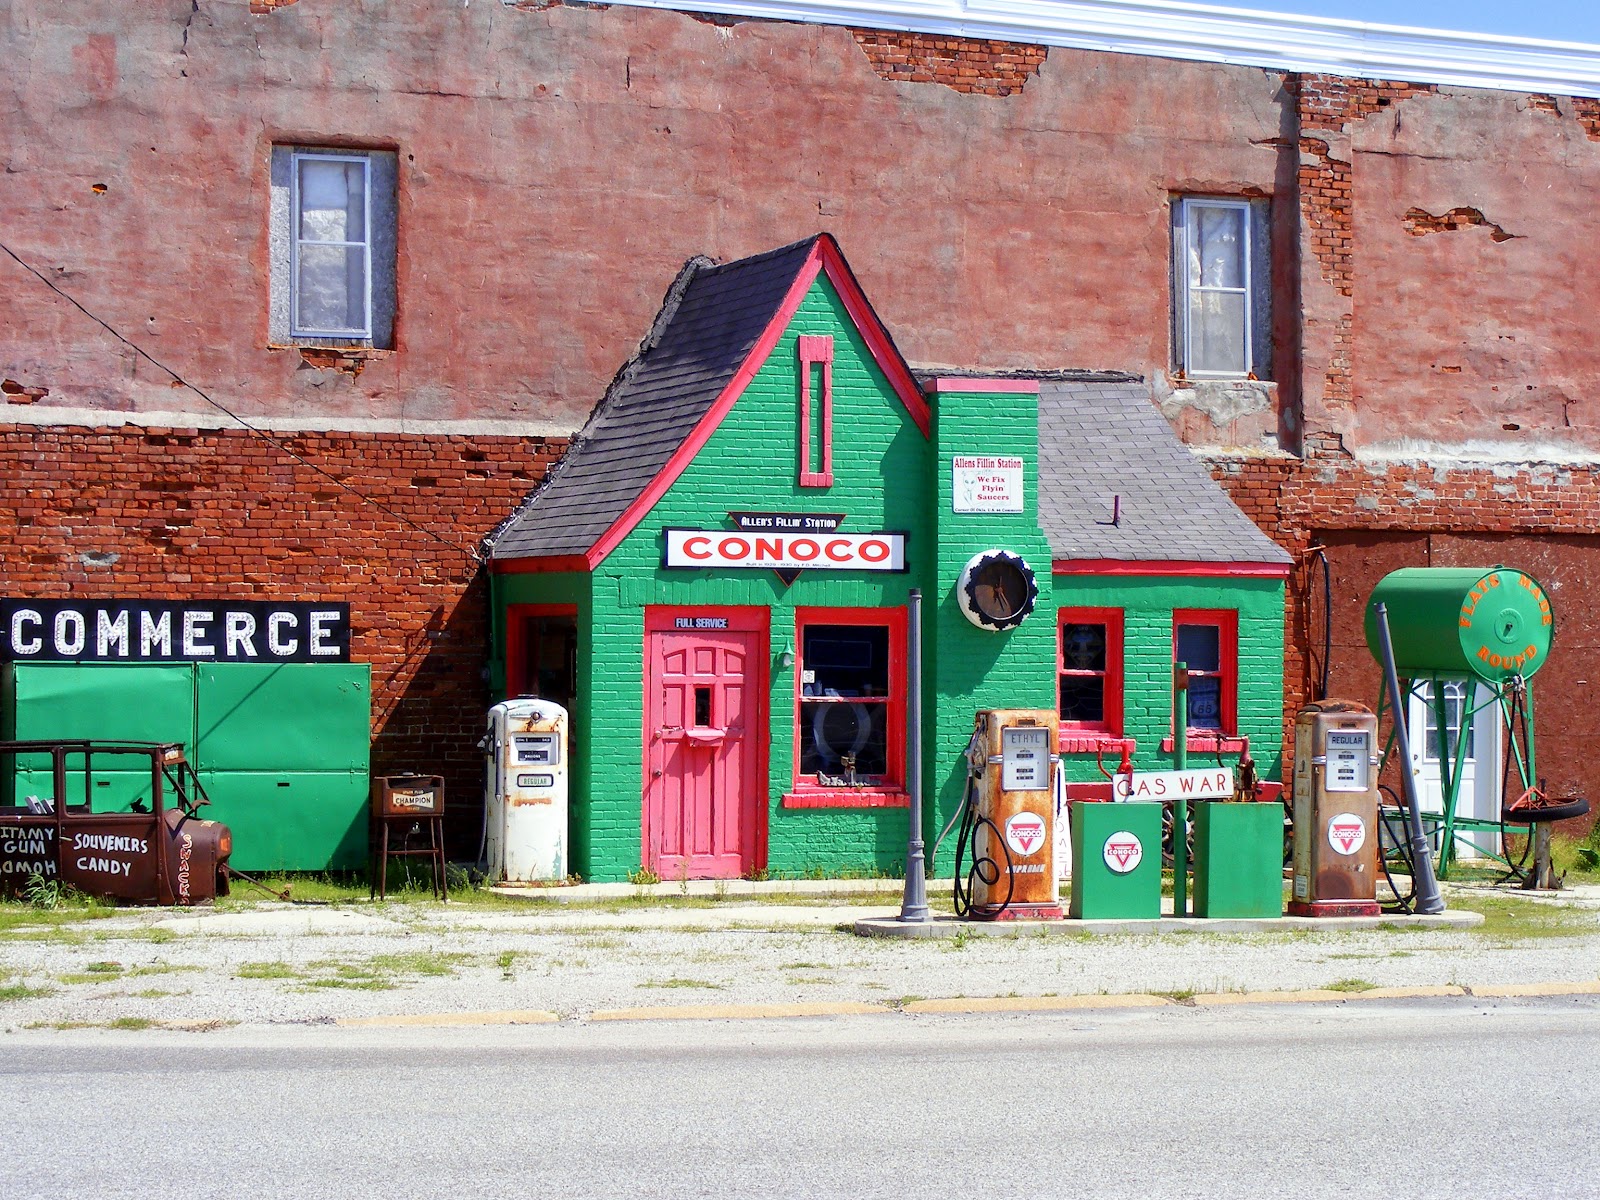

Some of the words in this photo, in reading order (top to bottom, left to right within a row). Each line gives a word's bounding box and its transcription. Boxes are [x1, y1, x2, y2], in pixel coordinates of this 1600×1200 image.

[954, 458, 975, 468] Allens
[976, 458, 996, 468] Fillin'
[998, 458, 1022, 468] Station
[741, 516, 772, 526] ALLEN'S
[805, 518, 836, 528] STATION
[682, 536, 890, 562] CONOCO
[1459, 574, 1500, 628] FLATS
[1519, 574, 1552, 626] MADE
[11, 608, 342, 657] COMMERCE
[676, 618, 694, 628] FULL
[696, 618, 727, 628] SERVICE
[1477, 644, 1537, 670] ROUND
[1198, 704, 1212, 714] 66
[1011, 734, 1040, 744] ETHYL
[1332, 736, 1363, 744] REGULAR
[1117, 778, 1166, 796] GAS
[1179, 774, 1226, 793] WAR
[4, 840, 46, 854] GUM
[73, 833, 148, 853] SOUVENIRS
[77, 856, 131, 877] CANDY
